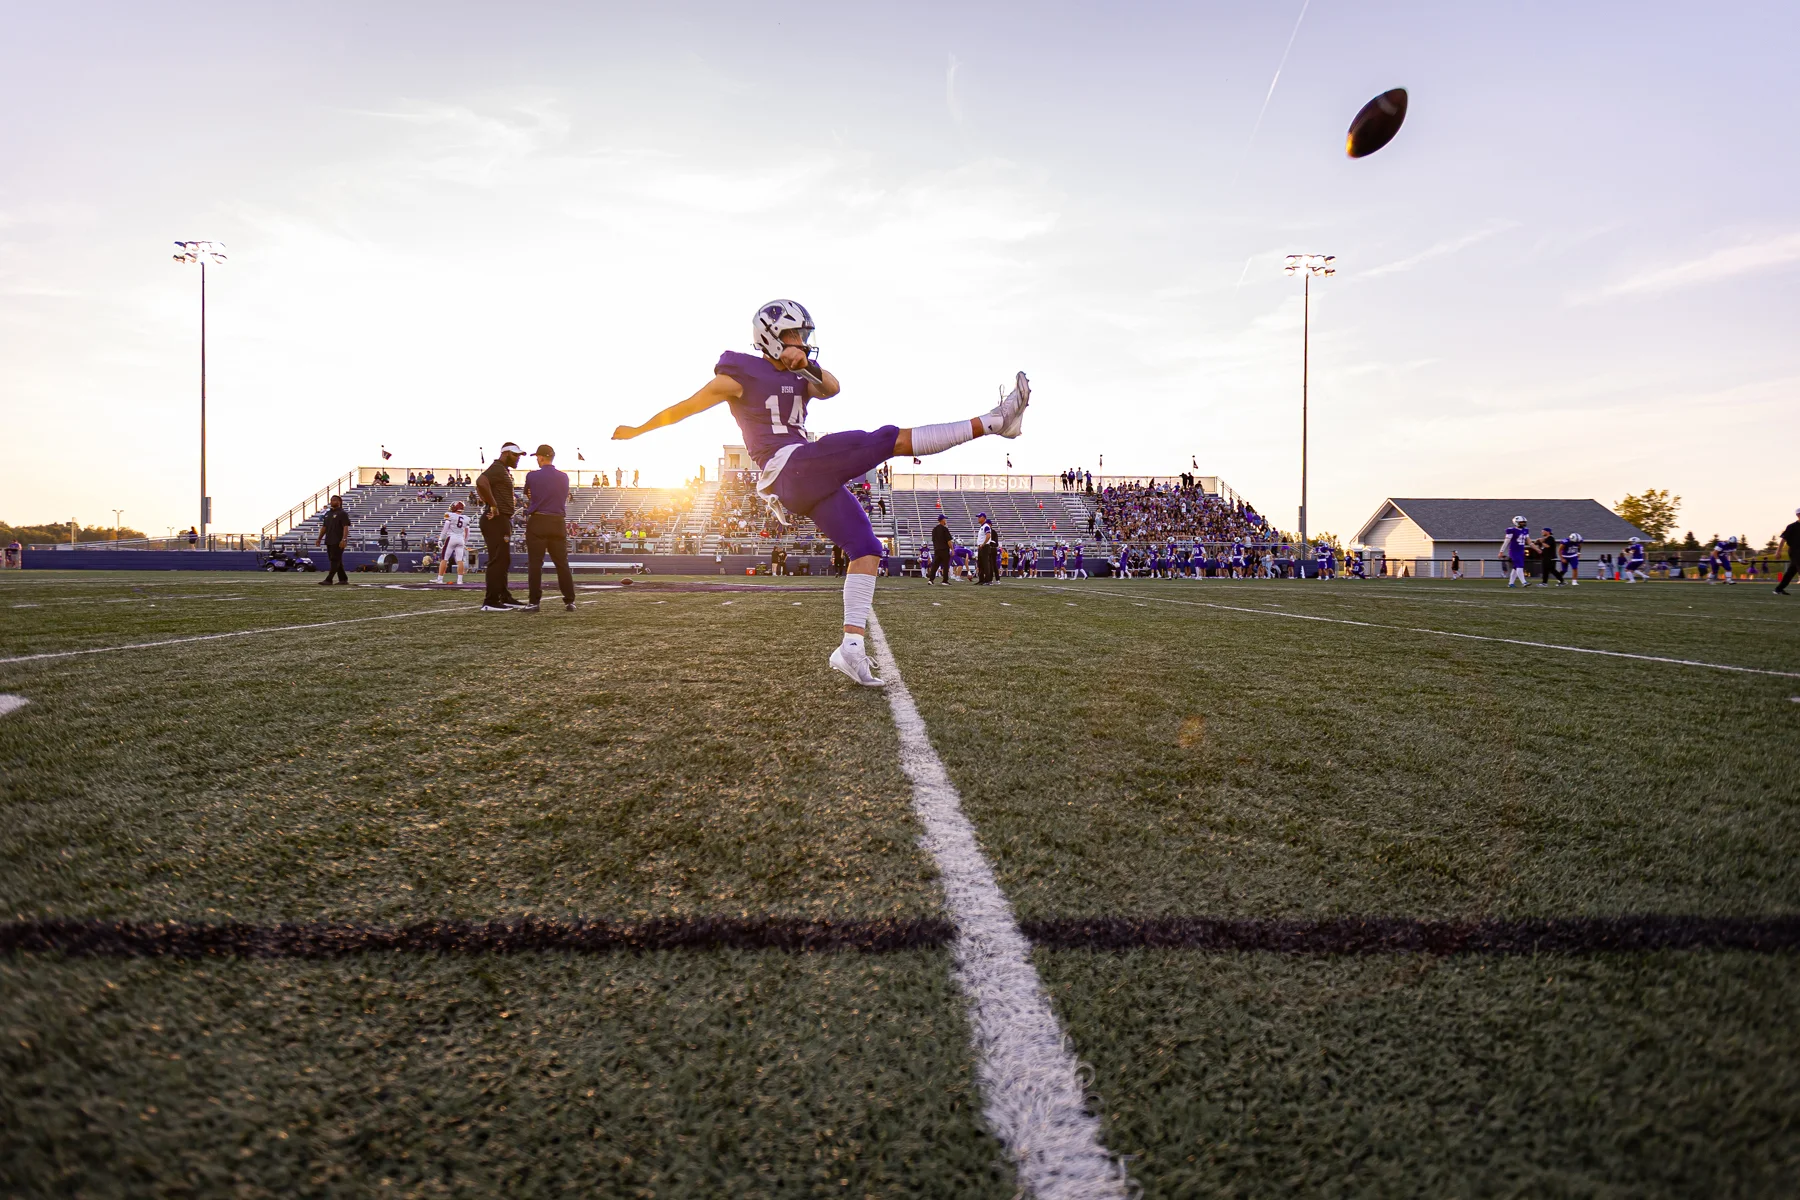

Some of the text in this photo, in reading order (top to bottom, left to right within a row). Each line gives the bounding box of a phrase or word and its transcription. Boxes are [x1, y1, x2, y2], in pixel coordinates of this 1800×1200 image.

[765, 395, 807, 438] 14
[981, 476, 1029, 489] BISON
[456, 516, 464, 528] 6
